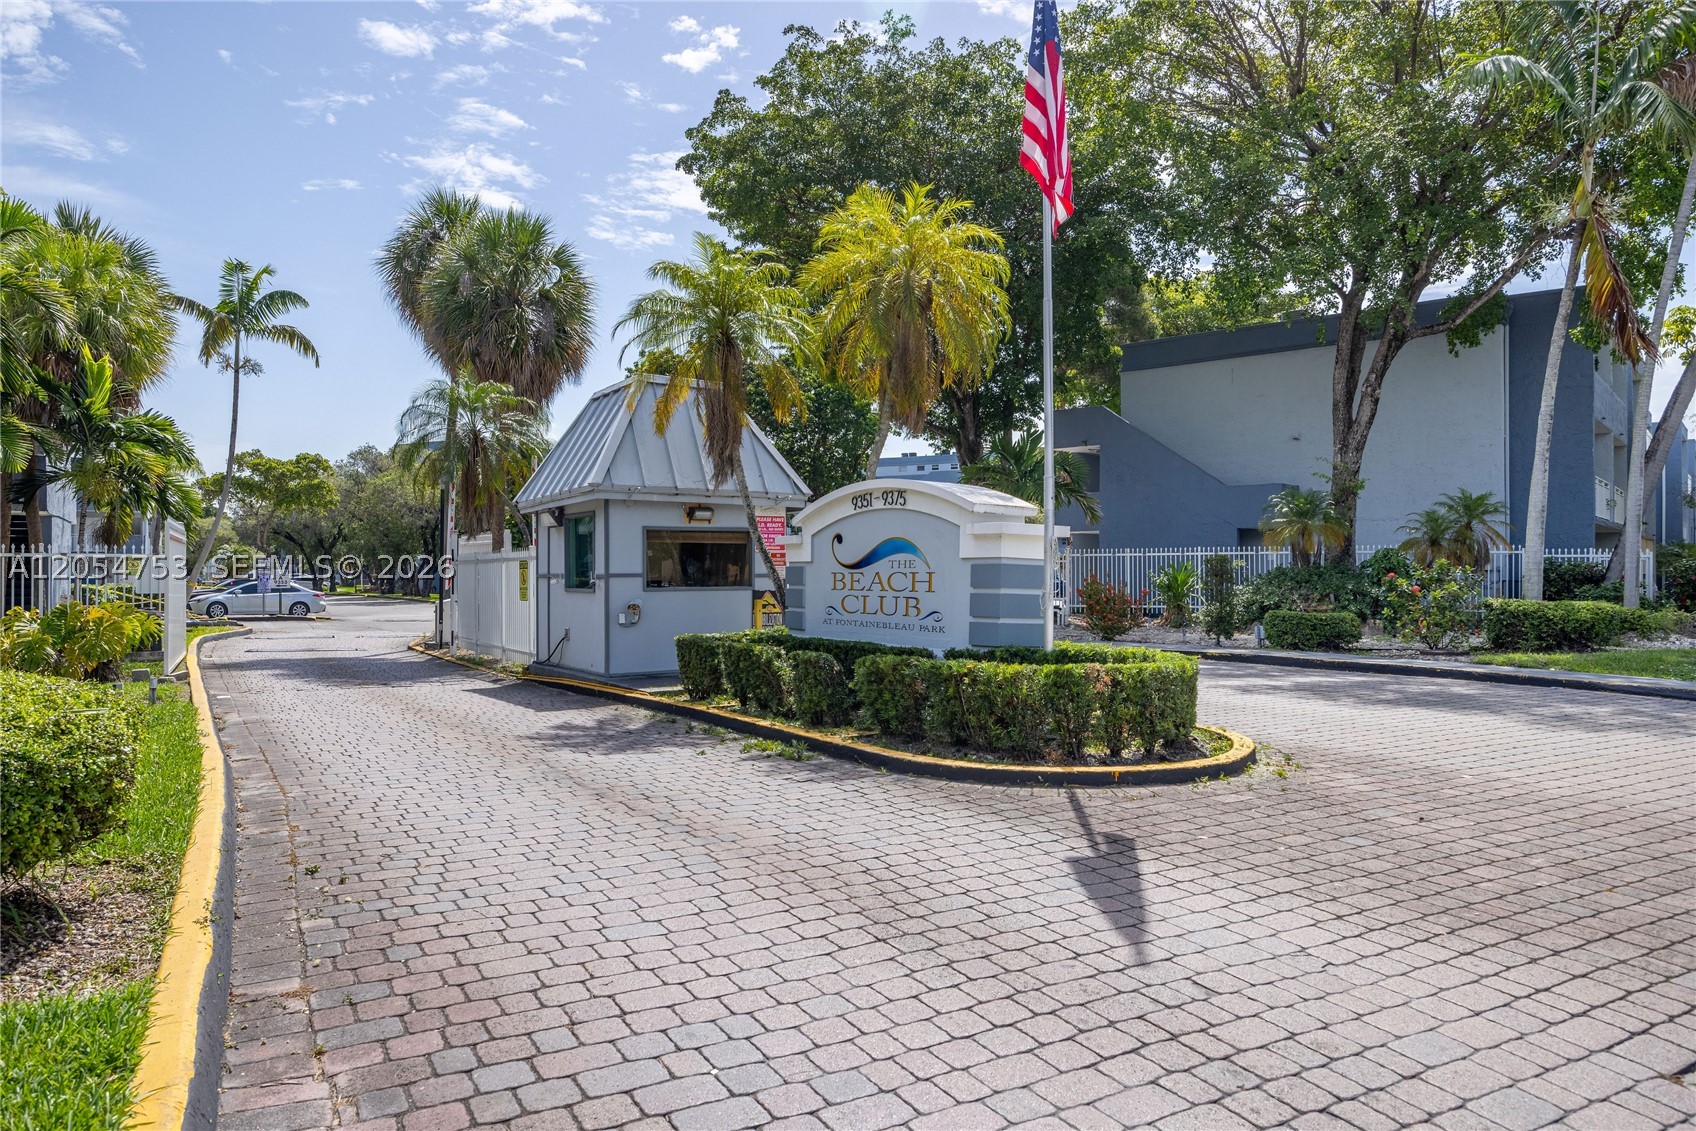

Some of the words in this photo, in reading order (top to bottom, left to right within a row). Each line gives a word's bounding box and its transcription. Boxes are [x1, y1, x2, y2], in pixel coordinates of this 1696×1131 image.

[888, 559, 917, 569] THE
[831, 571, 936, 593] BEACH
[841, 594, 922, 617] CLUB
[835, 619, 915, 632] FONTAINEBLEAU
[919, 624, 946, 634] PARK
